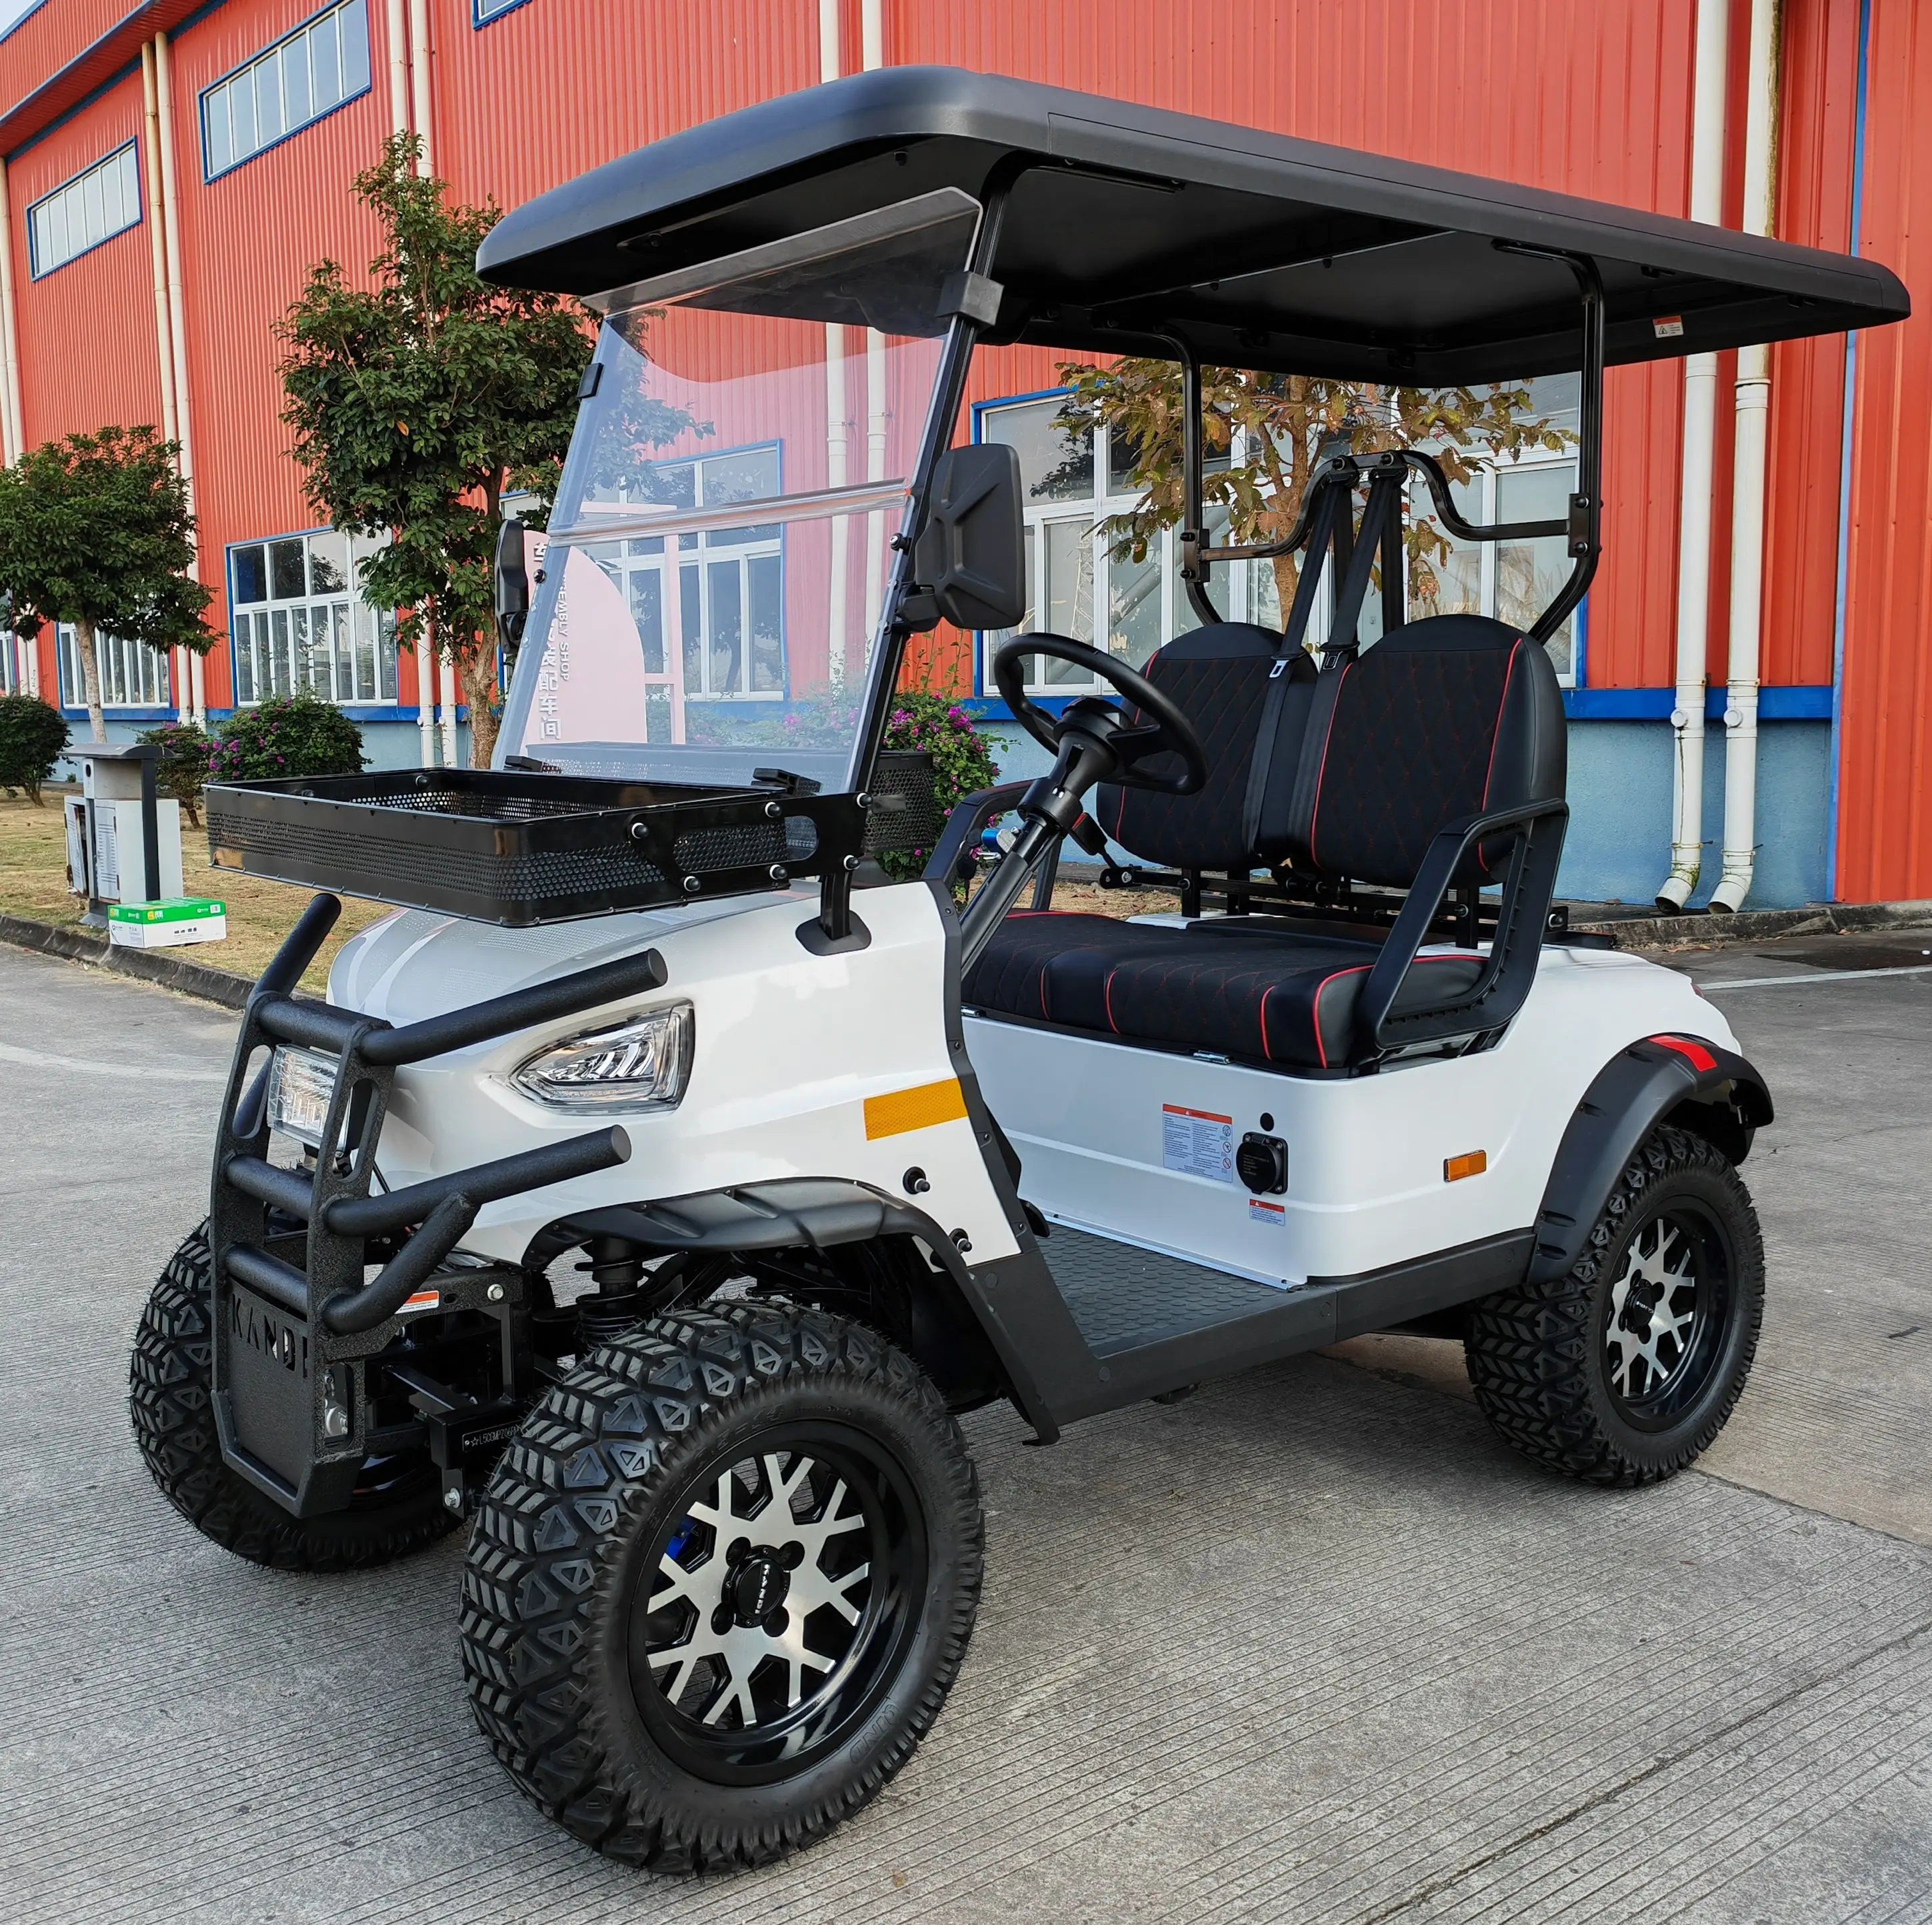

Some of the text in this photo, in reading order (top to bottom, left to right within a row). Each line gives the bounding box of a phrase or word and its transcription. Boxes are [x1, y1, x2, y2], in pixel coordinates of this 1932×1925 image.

[557, 575, 570, 681] EMBLY SHOP
[232, 1293, 308, 1378] KANDI
[755, 1564, 771, 1614] KANDI
